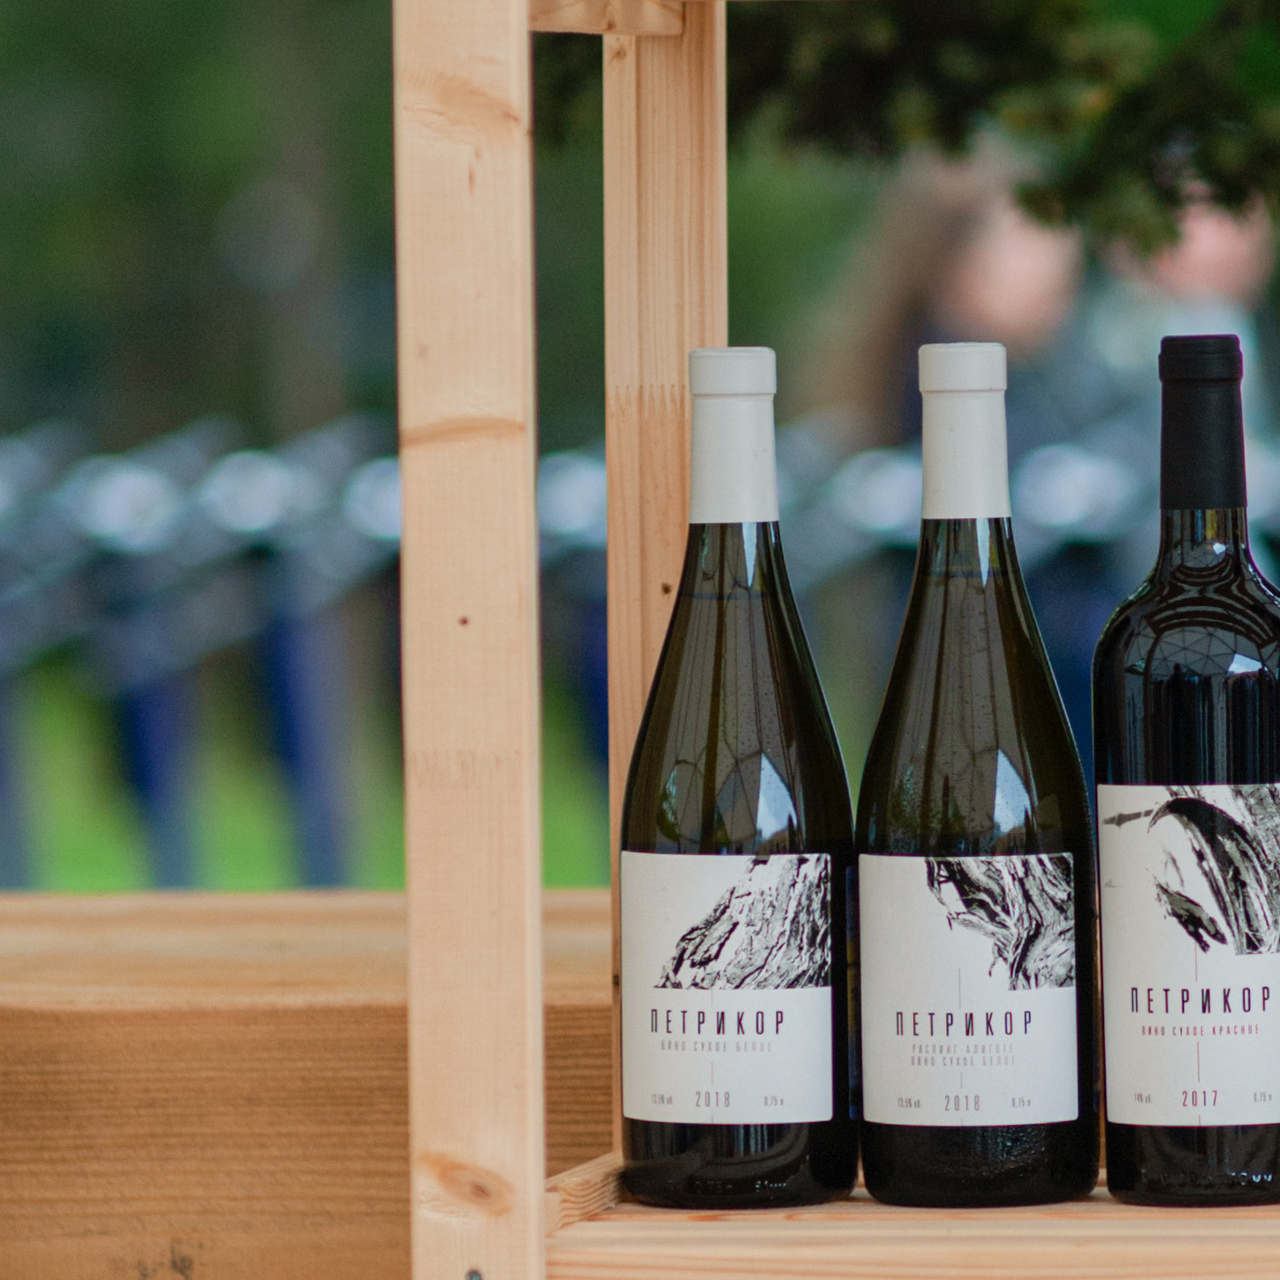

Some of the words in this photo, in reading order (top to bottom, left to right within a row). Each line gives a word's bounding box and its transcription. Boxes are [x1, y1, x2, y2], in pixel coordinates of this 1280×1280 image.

[1131, 987, 1270, 1014] ПЕТРИКОР
[651, 1009, 783, 1034] ПЕТРИКОР
[896, 1011, 1031, 1036] ПЕТРИКОР
[1142, 1026, 1165, 1036] ВИНО
[1173, 1026, 1204, 1036] СУХОЕ
[1212, 1024, 1258, 1036] КРАСНОЕ
[694, 1041, 726, 1052] СУХОЕ
[943, 1056, 974, 1066] СУХОЕ
[695, 1091, 730, 1107] 2018
[945, 1095, 980, 1111] 2018
[1182, 1090, 1218, 1107] 2017
